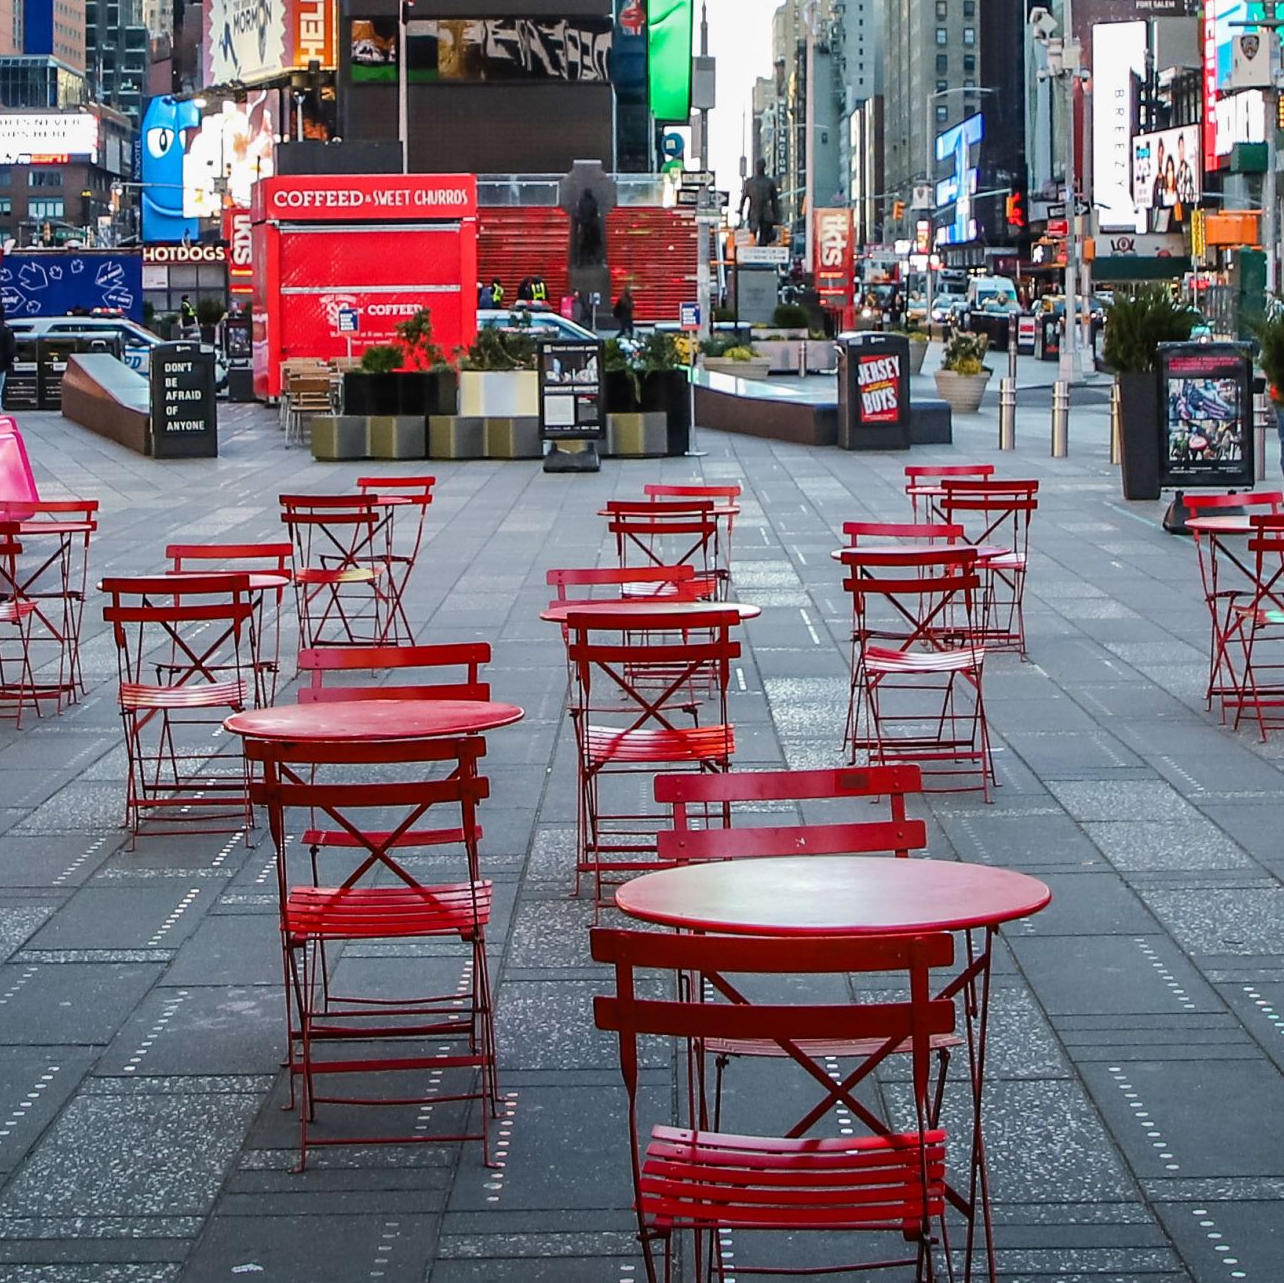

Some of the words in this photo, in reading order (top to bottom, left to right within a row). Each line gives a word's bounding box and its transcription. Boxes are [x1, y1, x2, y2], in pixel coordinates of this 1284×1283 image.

[1136, 0, 1152, 9] FORT
[1153, 0, 1175, 9] SALEM
[233, 1, 272, 36] MORMON
[1114, 90, 1126, 188] BREEZY
[273, 190, 364, 207] COFFEED
[373, 190, 411, 206] SWEET
[414, 189, 468, 205] CHURROS
[820, 213, 848, 267] tkts
[143, 246, 226, 262] HOTDOGS
[165, 362, 193, 373] DON'T
[857, 354, 900, 385] JERSEY
[165, 378, 178, 387] BE
[166, 391, 202, 400] AFRAID
[862, 388, 897, 415] BOYS
[166, 406, 179, 416] OF
[166, 421, 205, 431] ANYONE
